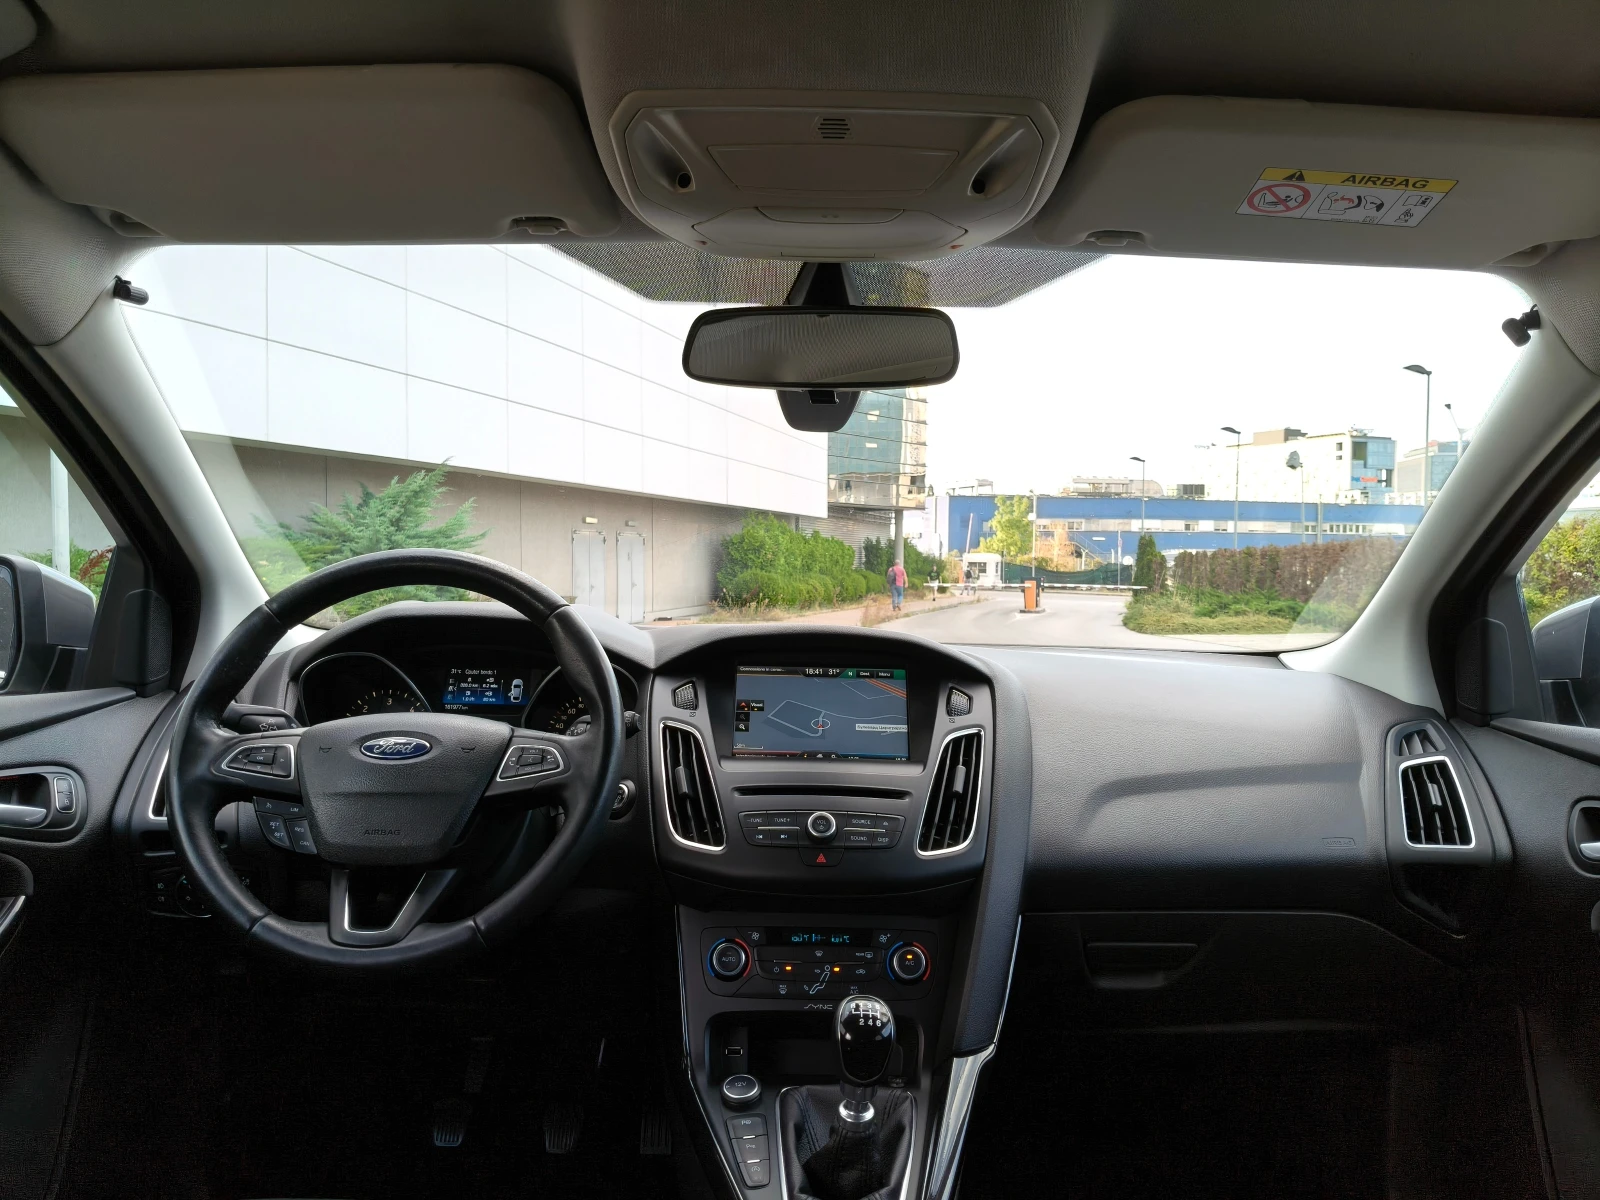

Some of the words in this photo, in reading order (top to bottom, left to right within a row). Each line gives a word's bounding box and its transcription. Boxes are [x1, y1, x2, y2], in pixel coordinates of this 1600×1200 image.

[1341, 174, 1430, 189] AIRBAG
[362, 705, 368, 713] 2
[373, 739, 416, 753] Ford
